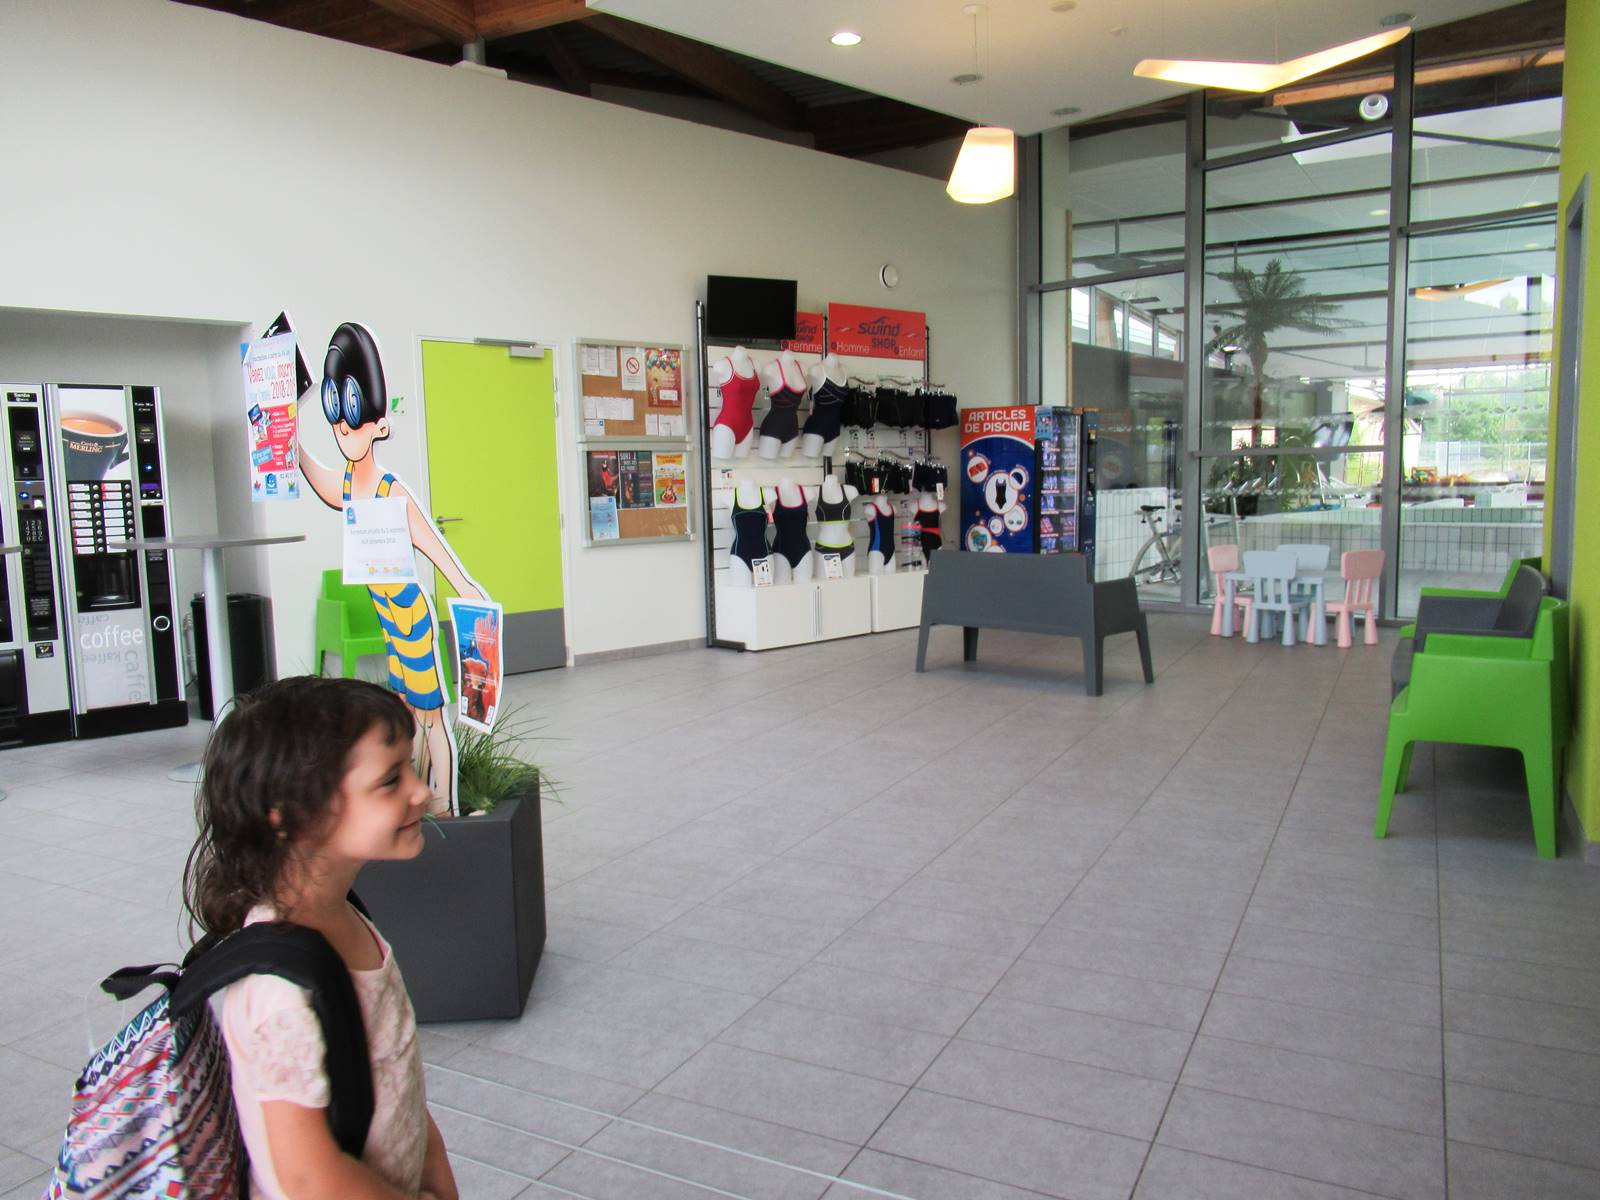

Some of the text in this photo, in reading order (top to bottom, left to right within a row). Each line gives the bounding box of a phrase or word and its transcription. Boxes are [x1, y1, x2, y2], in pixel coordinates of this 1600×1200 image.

[788, 341, 823, 353] Femme
[836, 341, 870, 354] Homme
[871, 337, 896, 349] SHOP
[899, 345, 925, 358] Enfant
[968, 410, 1027, 422] ARTICLES
[964, 420, 1031, 433] DE PISCINE
[80, 625, 144, 649] coffee
